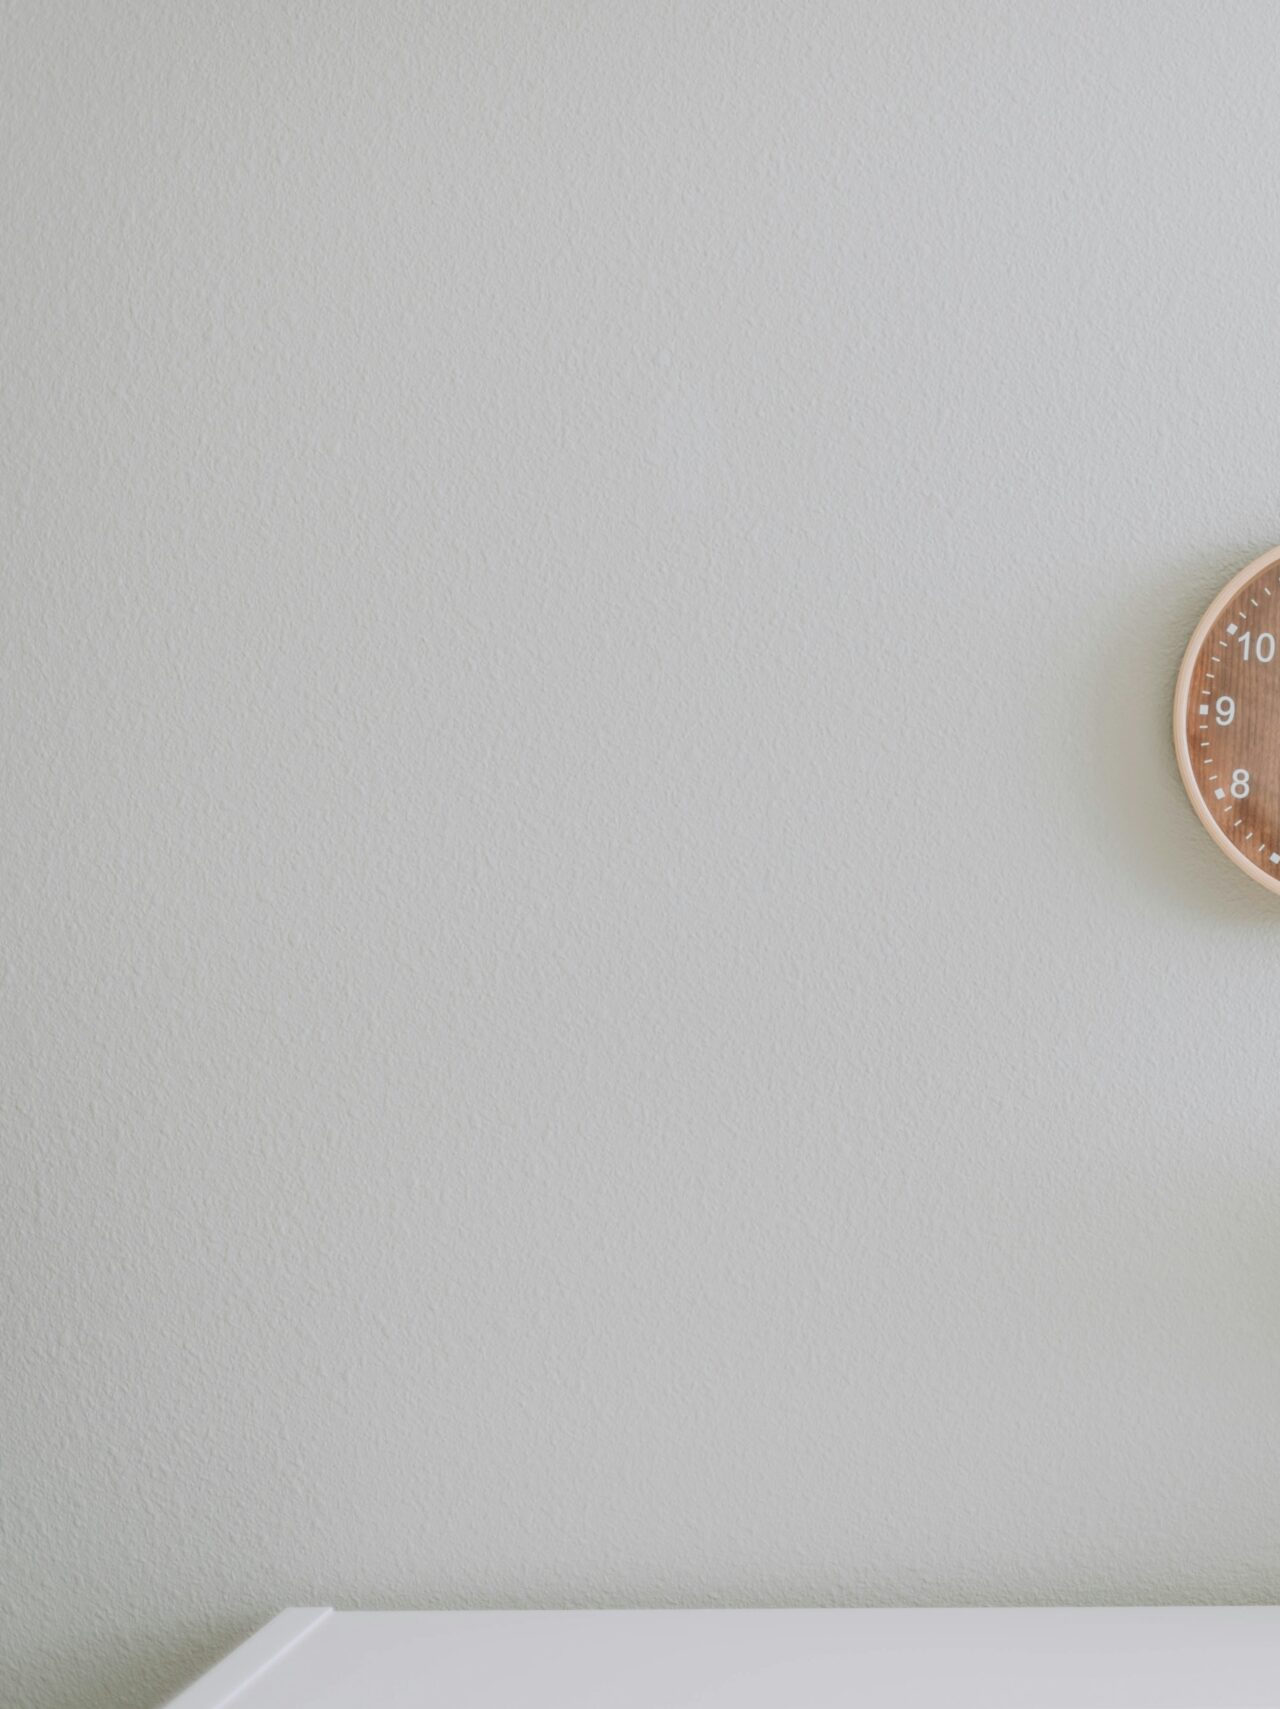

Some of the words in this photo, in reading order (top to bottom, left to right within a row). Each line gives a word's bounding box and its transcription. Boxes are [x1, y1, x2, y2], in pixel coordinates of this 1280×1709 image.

[1238, 631, 1276, 663] 10
[1215, 696, 1236, 726] 9
[1230, 769, 1250, 799] 8
